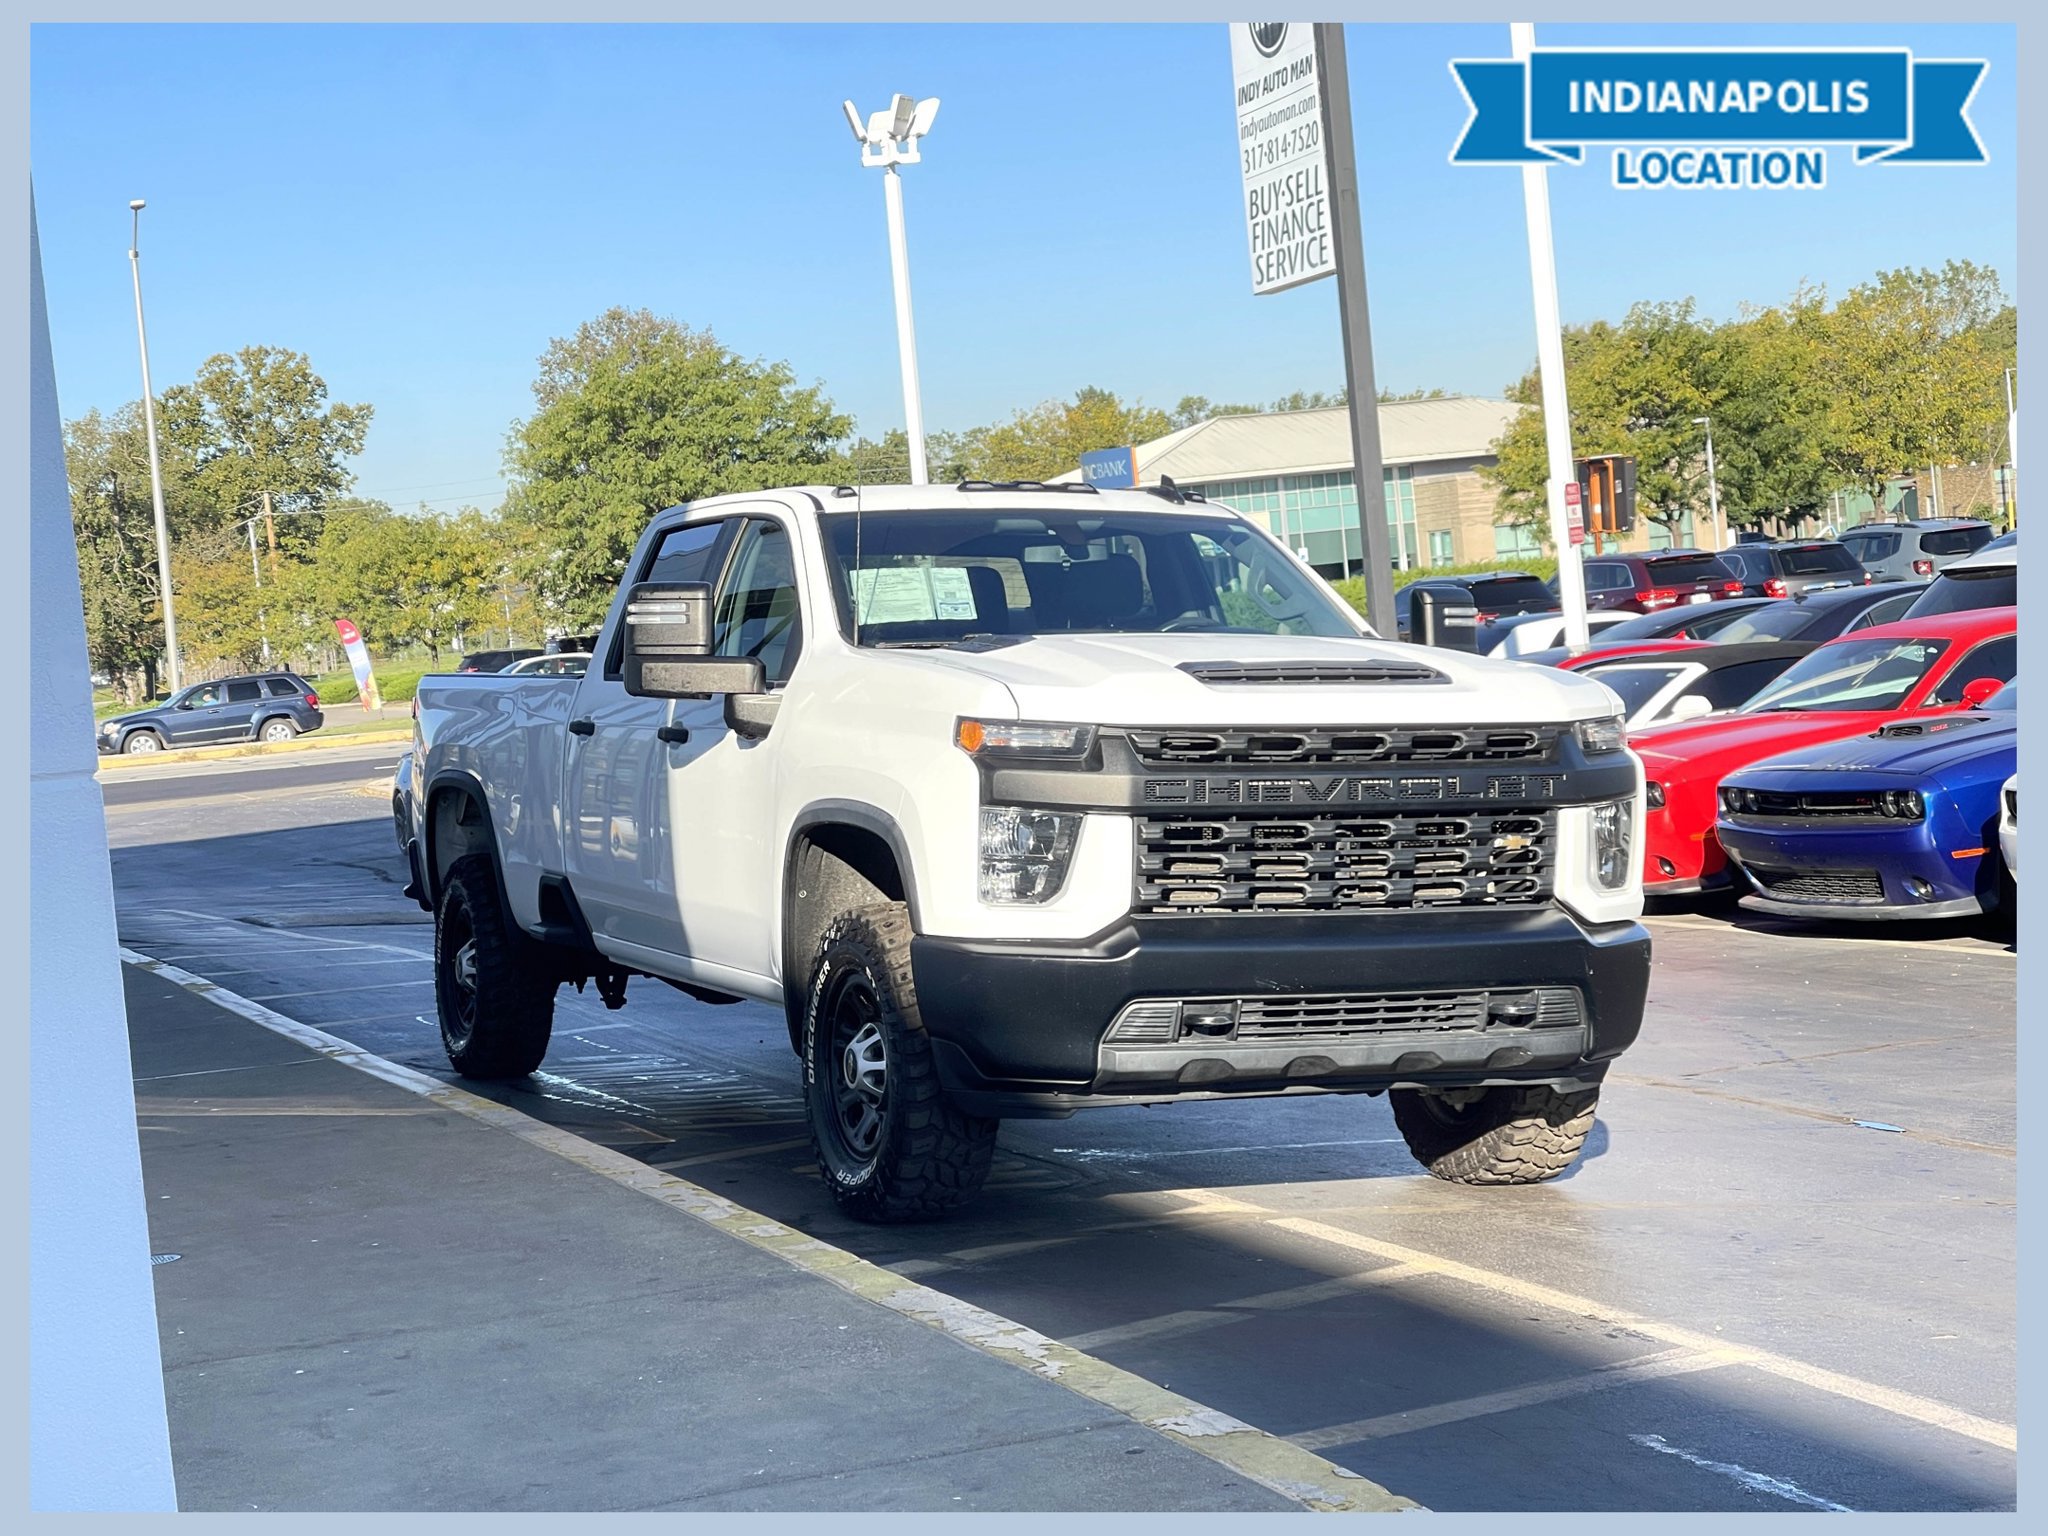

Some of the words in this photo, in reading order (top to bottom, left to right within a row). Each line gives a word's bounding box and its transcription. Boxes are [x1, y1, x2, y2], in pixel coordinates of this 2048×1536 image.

[1238, 79, 1261, 107] INDY
[1262, 66, 1288, 97] AUTO
[1290, 54, 1313, 83] MAN
[1240, 93, 1316, 140] indyautoman.com
[1252, 198, 1326, 253] FINANCE
[1255, 233, 1329, 286] SERVICE
[1145, 773, 1568, 803] CHEVROLET
[807, 959, 831, 1085] DISCOVERER
[836, 1156, 878, 1186] COOPER
